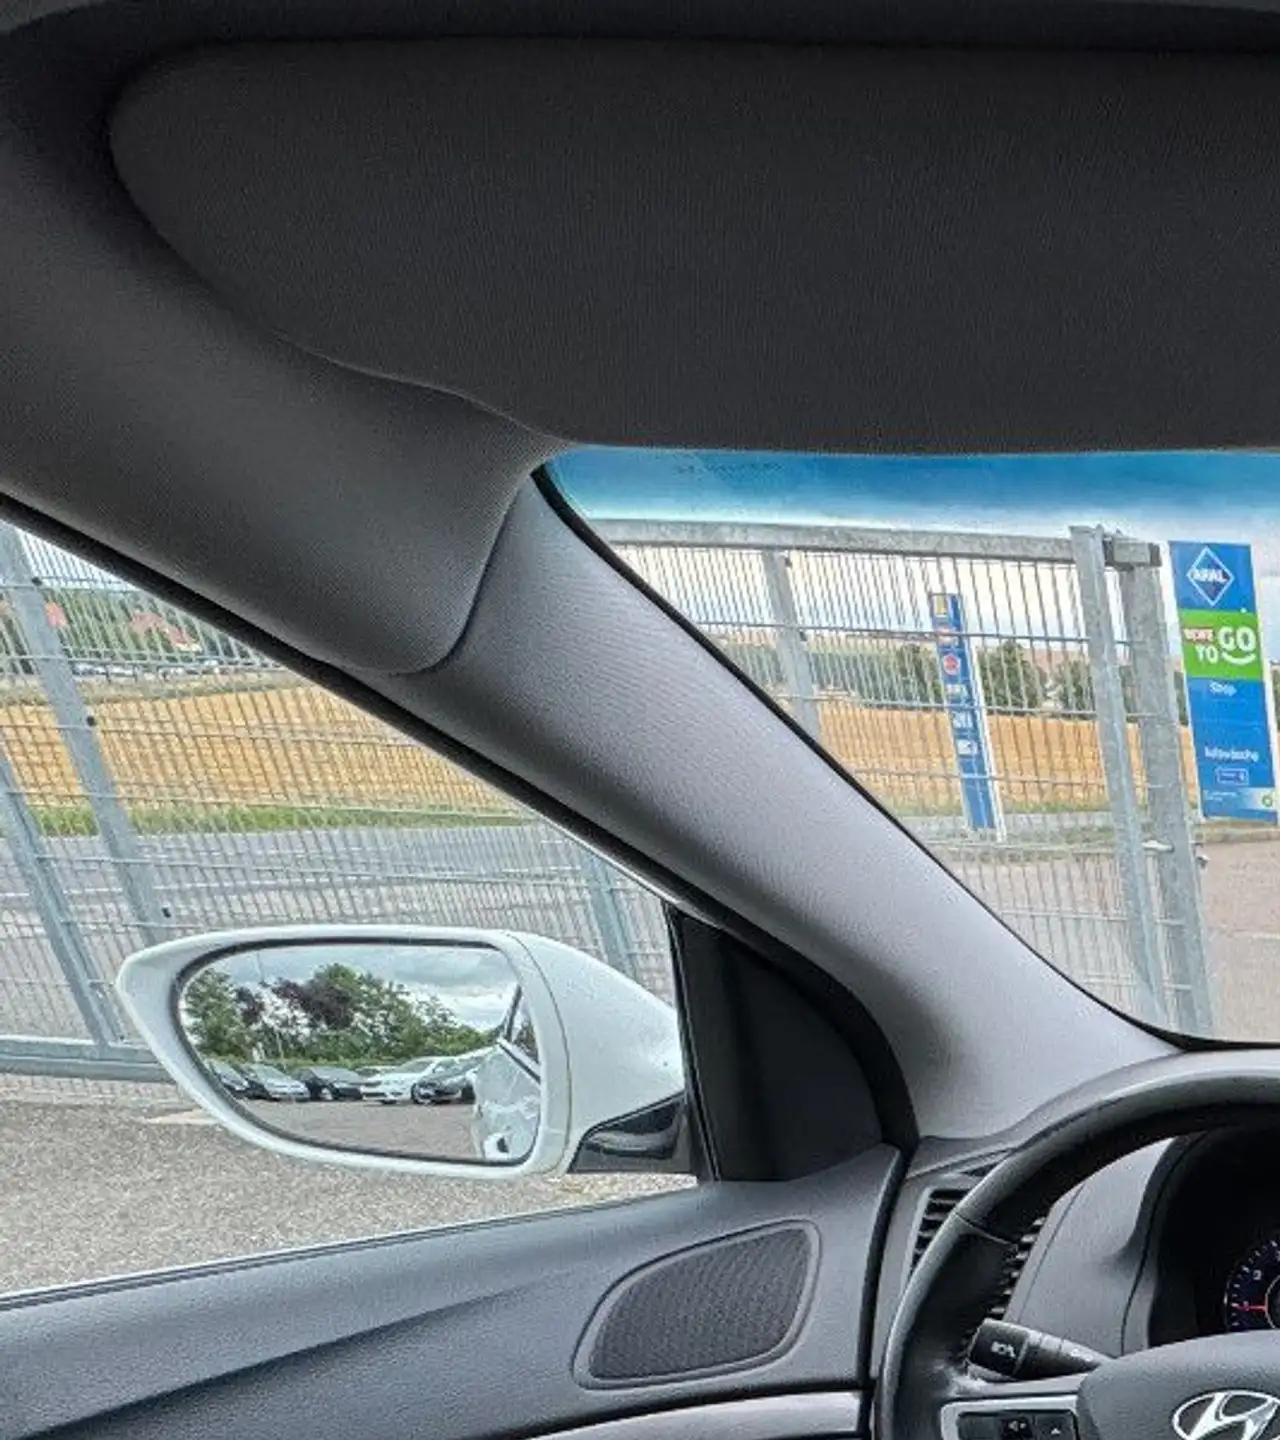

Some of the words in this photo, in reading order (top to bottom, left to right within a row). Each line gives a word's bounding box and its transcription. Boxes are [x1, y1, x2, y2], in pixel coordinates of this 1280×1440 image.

[1192, 568, 1227, 583] ARAL
[1218, 626, 1256, 652] GO
[1195, 644, 1218, 664] TO
